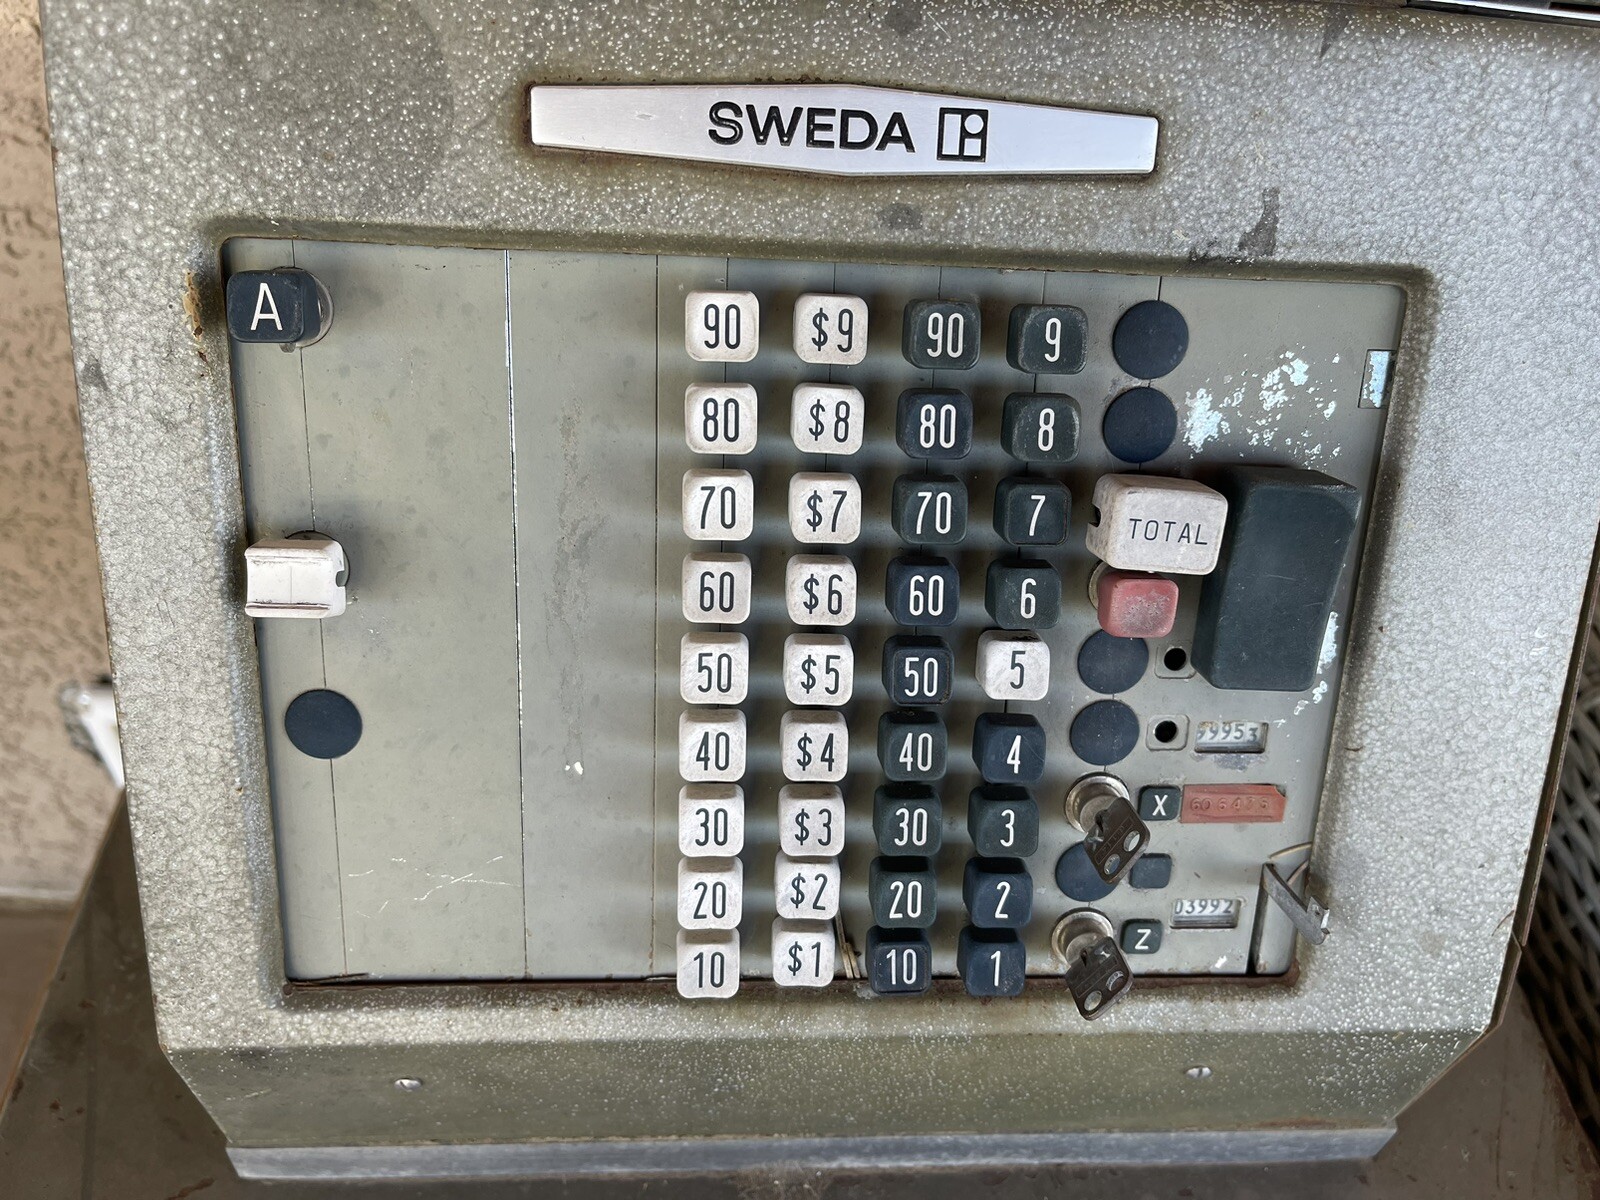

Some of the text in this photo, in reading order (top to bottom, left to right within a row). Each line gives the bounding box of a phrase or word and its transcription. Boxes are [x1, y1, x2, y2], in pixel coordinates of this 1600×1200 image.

[707, 101, 916, 153] SWEDA
[250, 282, 283, 331] A
[704, 303, 741, 349] 90
[811, 307, 854, 353] $9
[926, 312, 964, 358] 90
[1044, 317, 1061, 362] 9
[703, 398, 739, 442] 80
[808, 399, 850, 443] $8
[919, 403, 956, 449] 80
[1037, 407, 1056, 451] 8
[700, 486, 736, 530] 70
[806, 490, 848, 533] $7
[915, 491, 951, 534] 70
[1028, 495, 1046, 536] 7
[1129, 518, 1208, 545] TOTAL
[699, 571, 735, 612] 60
[802, 573, 843, 615] $6
[908, 575, 944, 616] 60
[1020, 578, 1037, 619] 6
[697, 653, 732, 693] 50
[800, 654, 841, 695] $5
[904, 657, 939, 697] 50
[1010, 650, 1026, 689] 5
[695, 731, 730, 771] 40
[796, 733, 835, 772] $4
[899, 733, 933, 772] 40
[1006, 735, 1021, 774] 4
[1152, 795, 1168, 816] X
[694, 807, 729, 846] 30
[794, 808, 832, 846] $3
[894, 808, 928, 846] 30
[1000, 809, 1014, 847] 3
[693, 881, 726, 919] 20
[789, 872, 828, 911] $2
[889, 881, 922, 918] 20
[994, 881, 1010, 919] 2
[787, 941, 821, 977] $1
[1134, 929, 1151, 949] Z
[693, 951, 725, 988] 10
[886, 948, 917, 985] 10
[990, 950, 1001, 986] 1
